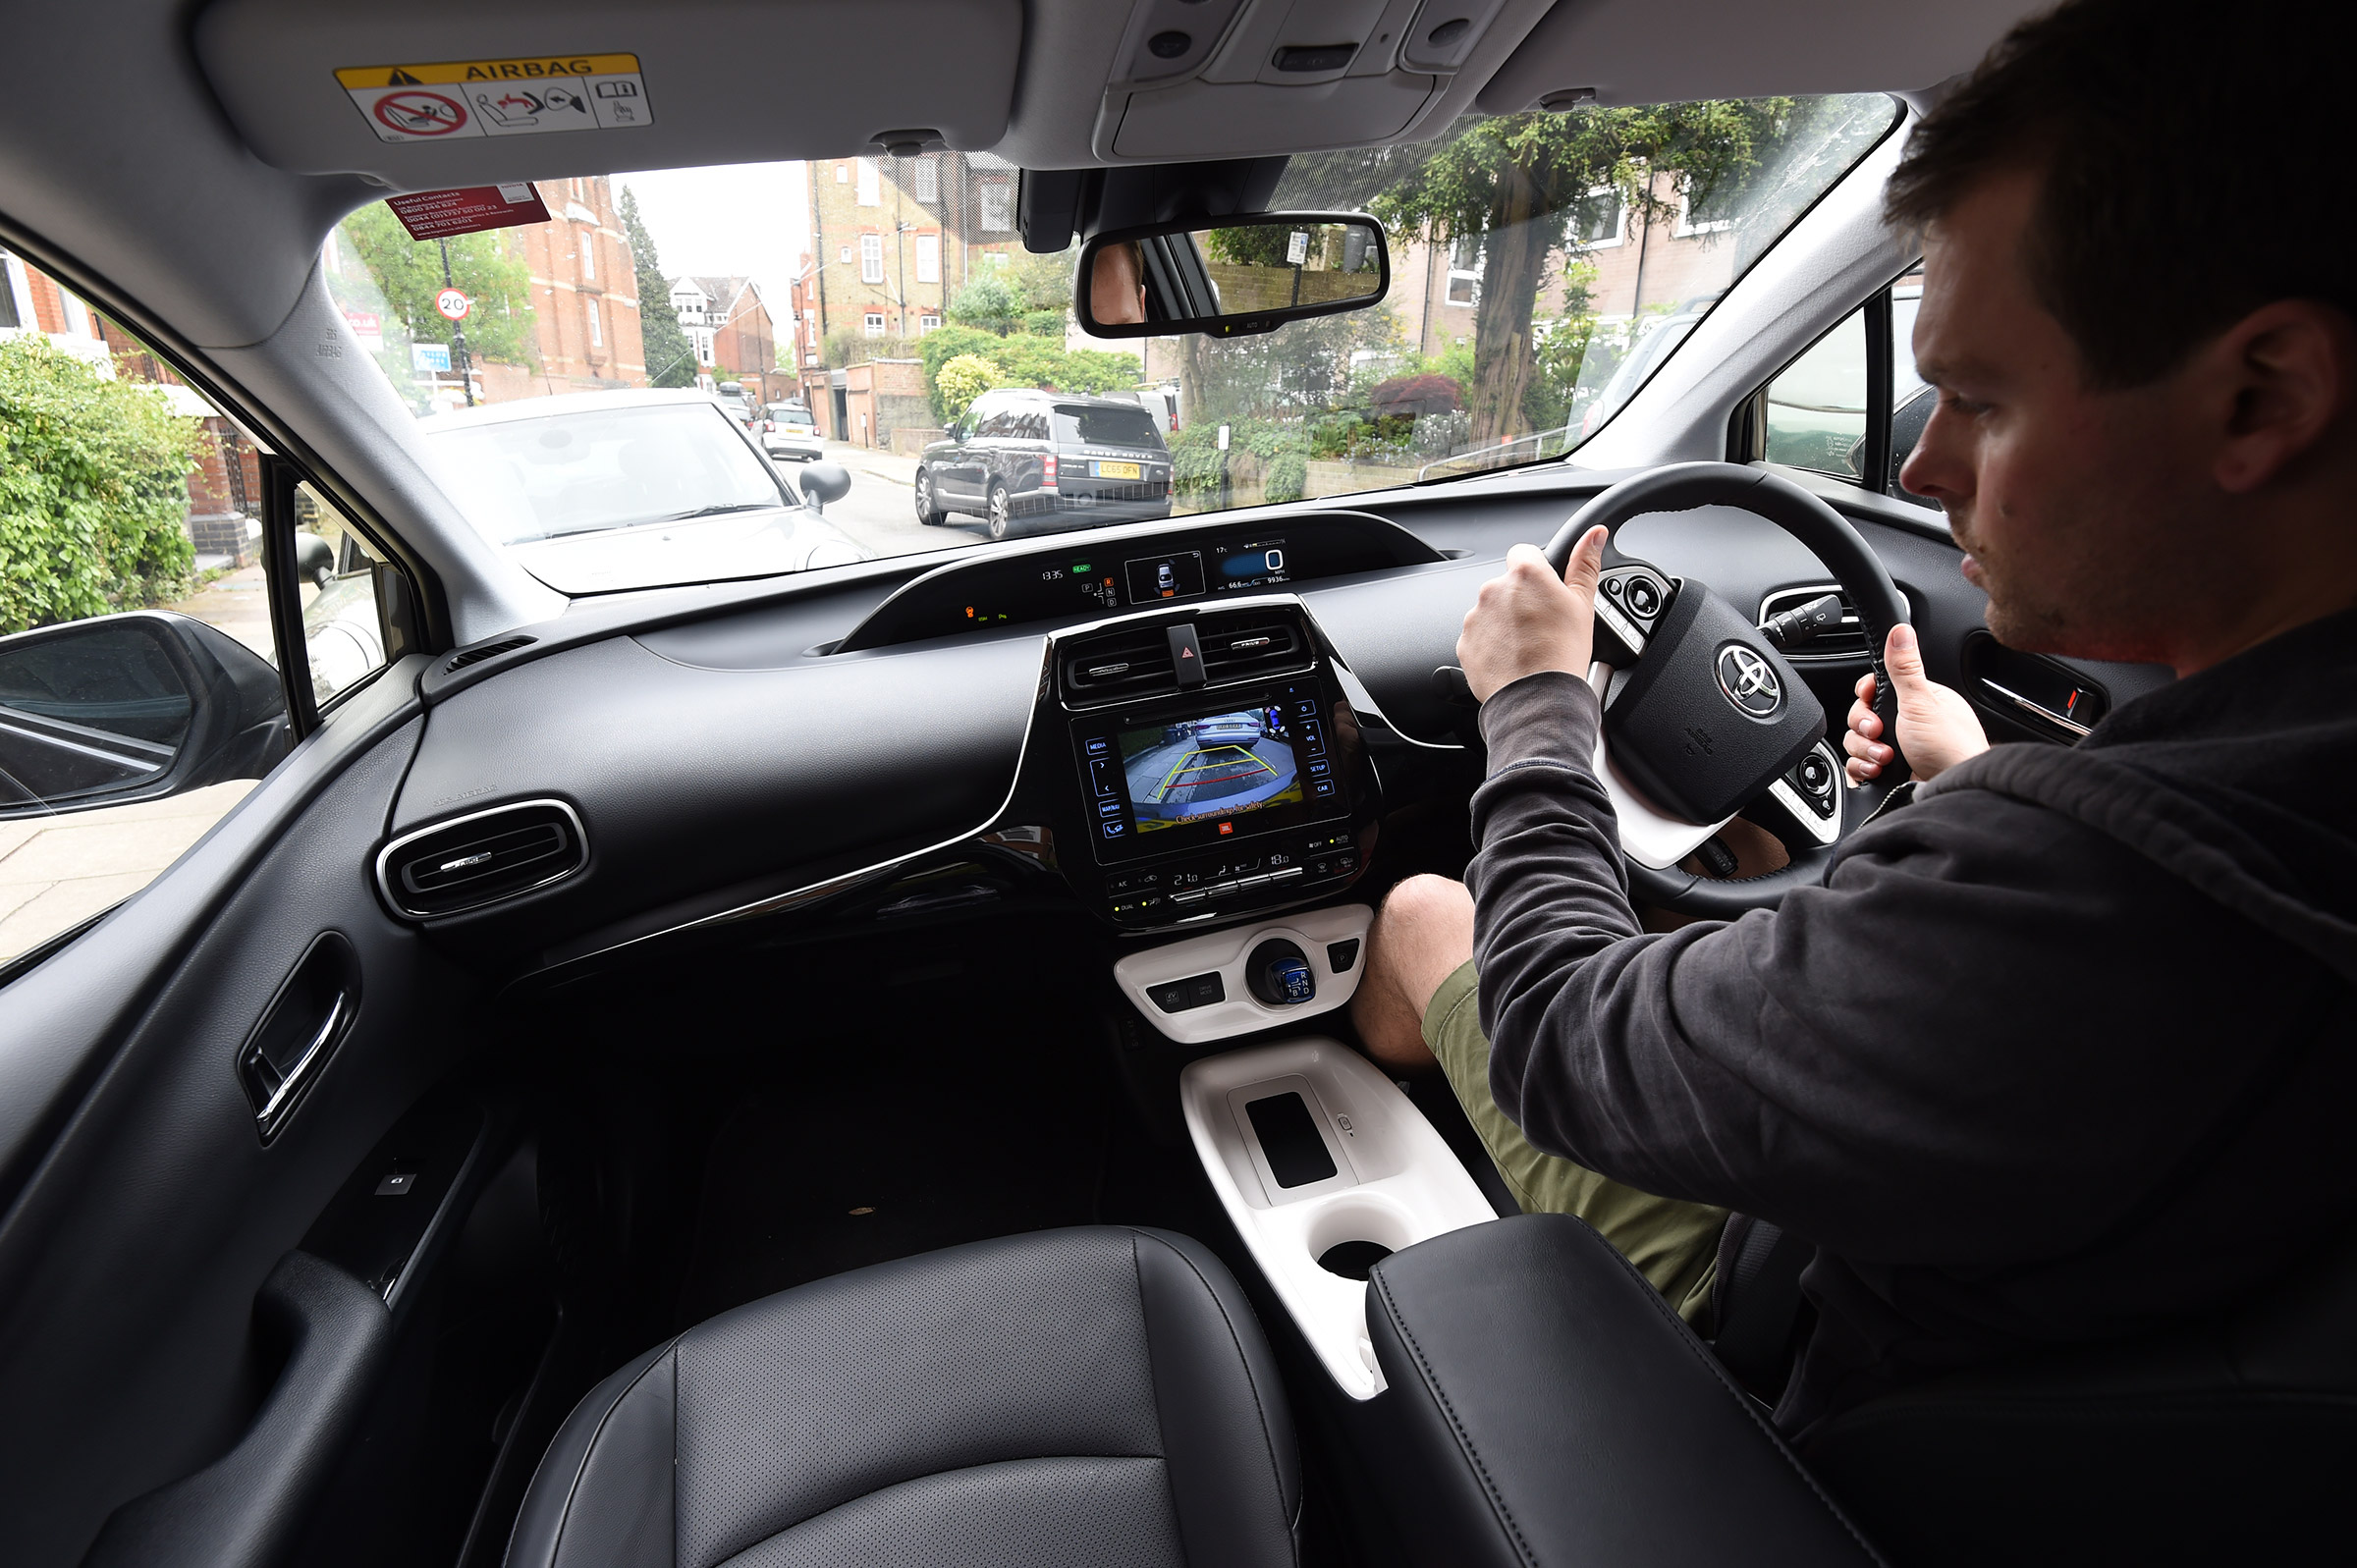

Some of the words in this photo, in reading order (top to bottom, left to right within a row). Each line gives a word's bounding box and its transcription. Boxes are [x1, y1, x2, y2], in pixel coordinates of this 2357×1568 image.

[466, 59, 592, 81] AIRBAG
[393, 196, 421, 206] Useful
[421, 191, 461, 202] Contacts
[442, 297, 465, 310] 20
[1083, 449, 1118, 458] RANGE
[1265, 549, 1284, 570] 0
[1073, 565, 1091, 573] READY
[1090, 741, 1107, 750] MEDIA
[1309, 764, 1326, 773] SETUP
[1176, 813, 1195, 824] Check
[1196, 806, 1234, 821] surroundings
[1234, 803, 1244, 813] for
[1271, 854, 1289, 865] 18.0
